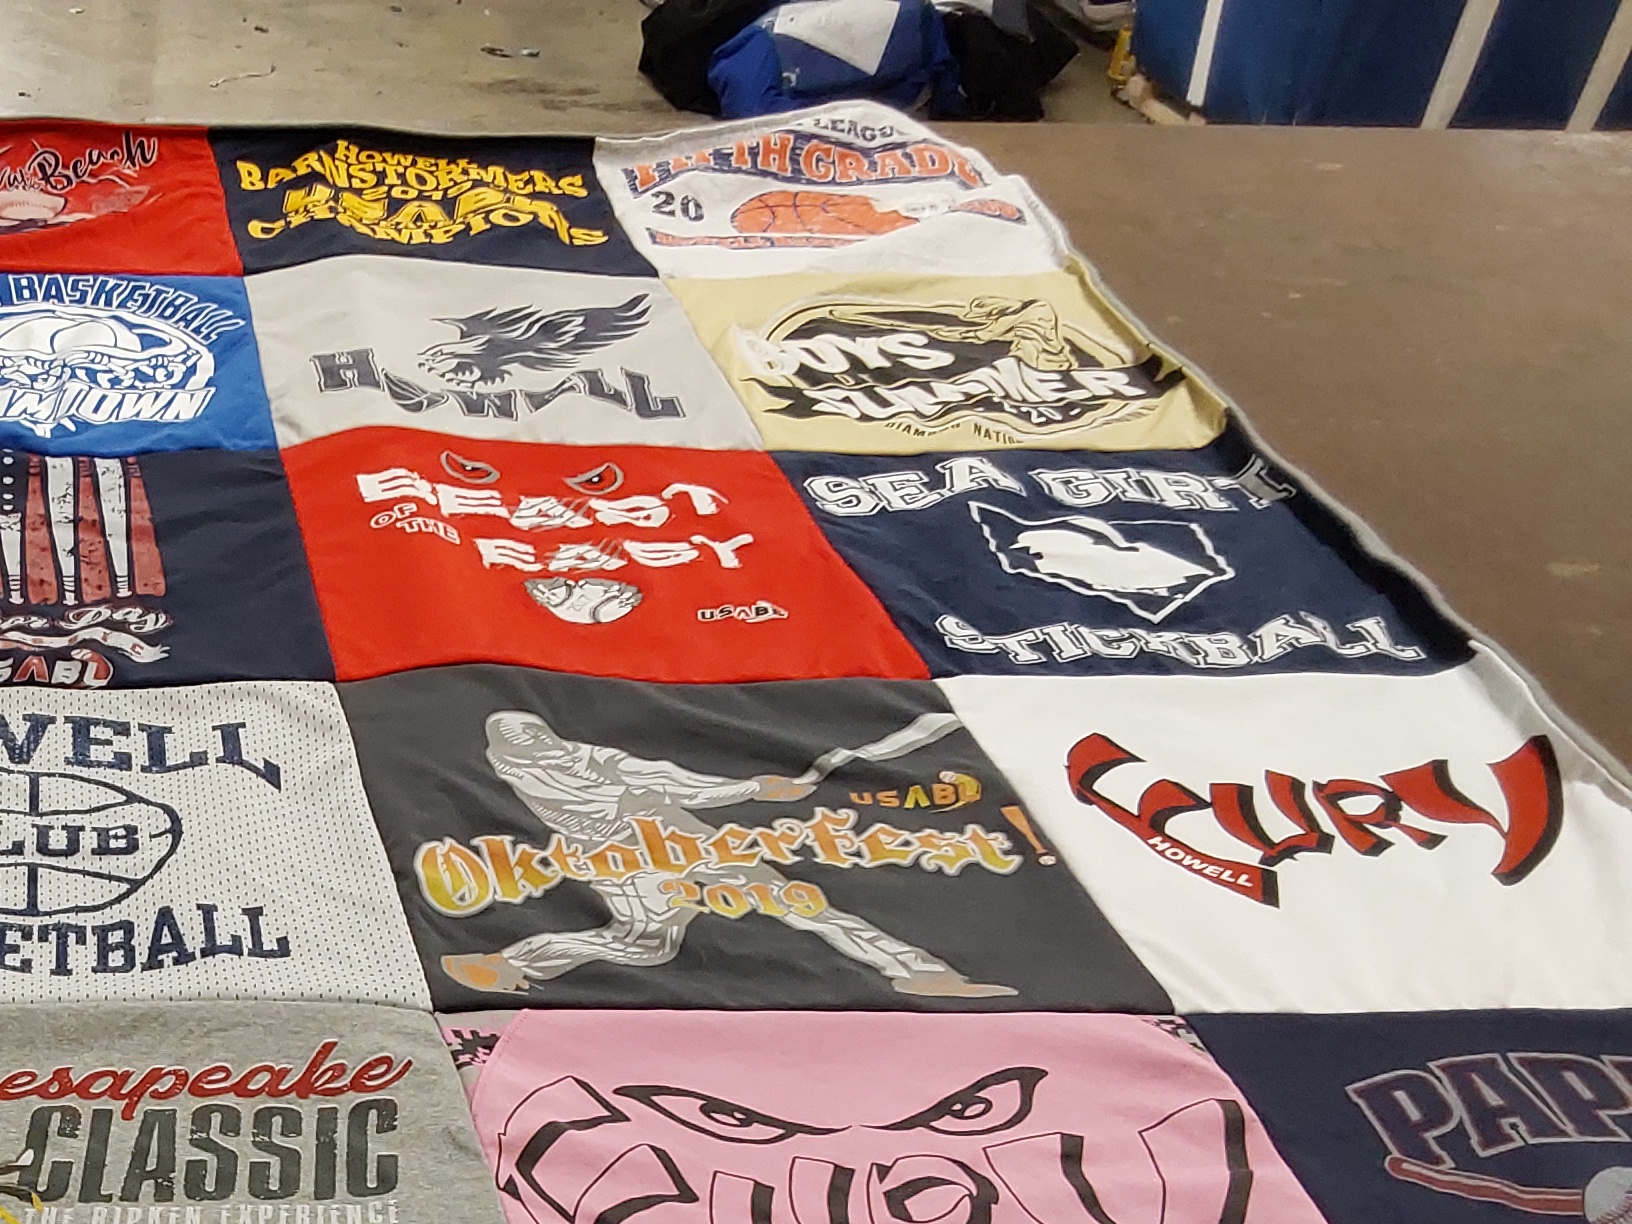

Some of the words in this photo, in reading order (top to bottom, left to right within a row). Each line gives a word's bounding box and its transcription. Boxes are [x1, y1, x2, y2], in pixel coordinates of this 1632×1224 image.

[813, 118, 909, 142] LEAGU
[236, 149, 589, 198] BARNSTORMERS
[8, 273, 247, 343] BASKETBALL
[973, 422, 1025, 445] NATIO
[355, 466, 730, 532] BEAST
[802, 455, 1029, 516] SEA
[369, 502, 418, 530] OF
[396, 517, 462, 546] THE
[59, 603, 174, 634] Day
[935, 608, 1426, 668] STICKBALL
[849, 771, 983, 813] USABL
[1063, 732, 1566, 909] FURY
[1146, 833, 1255, 889] HOWELL
[660, 876, 829, 919] 2019
[24, 1097, 401, 1204] CLASSIC
